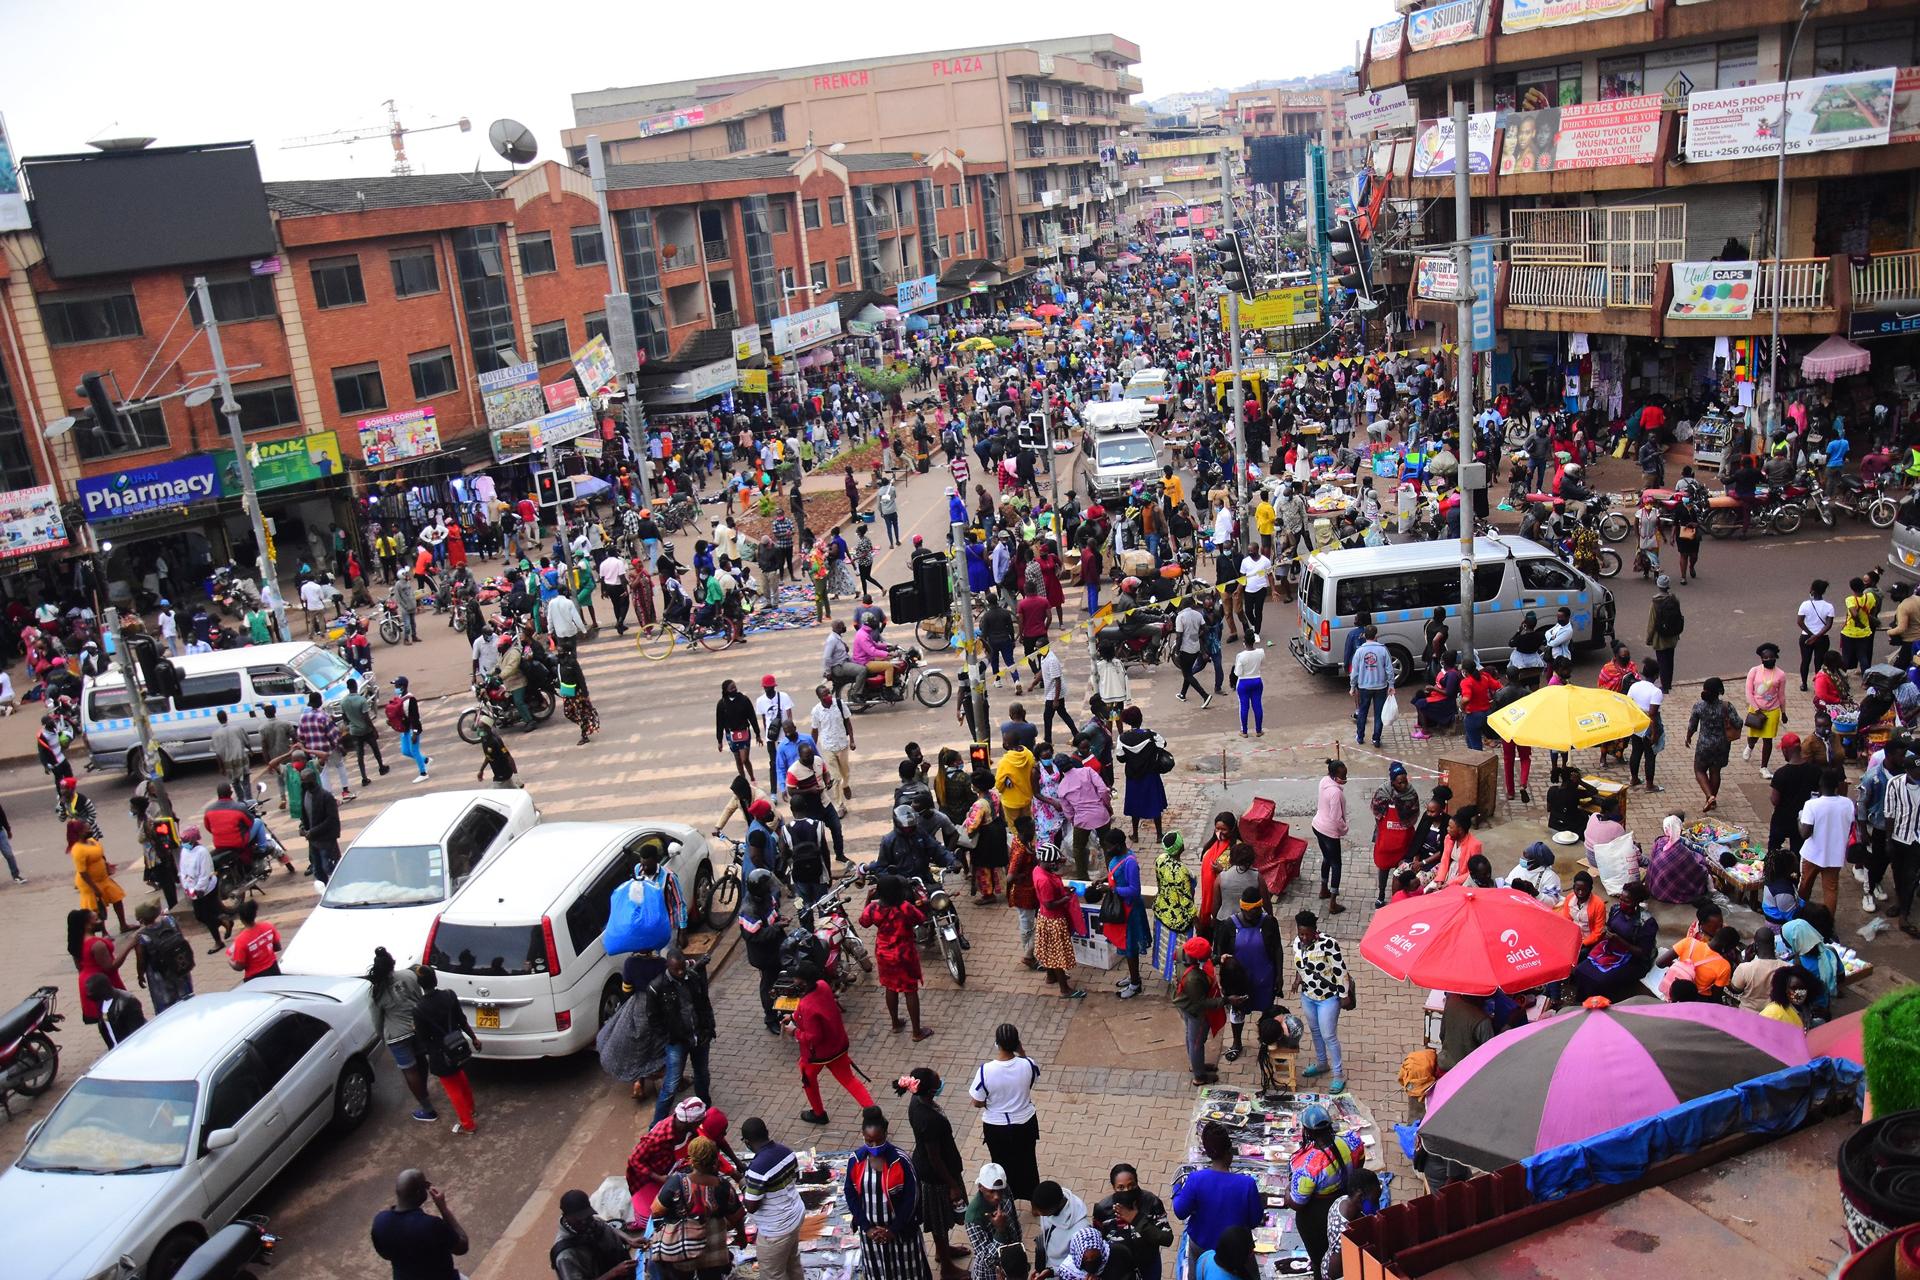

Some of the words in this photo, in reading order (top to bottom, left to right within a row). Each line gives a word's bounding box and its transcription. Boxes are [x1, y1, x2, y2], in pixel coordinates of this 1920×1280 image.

[1542, 2, 1581, 17] FINANCIAL
[813, 69, 869, 92] FRENCH
[931, 56, 983, 77] PLAZA
[1561, 105, 1587, 117] BABY
[1588, 102, 1614, 114] FACE
[1692, 98, 1739, 112] DREAMS
[1727, 105, 1765, 115] MASTERS
[1563, 119, 1589, 129] WHICH
[1589, 115, 1620, 127] NUMBER
[1623, 113, 1639, 123] ARE
[1571, 130, 1600, 141] JANGU
[1603, 125, 1650, 137] TUKOLEKO
[1575, 137, 1628, 149] OKUSINZILA
[1629, 135, 1642, 144] KU
[1577, 147, 1608, 157] NAMBA
[1692, 150, 1713, 159] TEL:
[1716, 147, 1740, 156] +256
[1557, 159, 1575, 169] Call:
[1576, 154, 1628, 168] 0700-852230
[1427, 261, 1453, 274] BRIGHT
[1714, 271, 1744, 279] CAPS
[900, 281, 927, 303] ELEGANT
[1881, 318, 1920, 332] SLEE
[480, 369, 506, 385] MOVIE
[507, 362, 536, 378] CENTRE
[365, 415, 394, 427] GOMESI
[394, 410, 425, 421] CORNER
[19, 486, 49, 496] POINT
[85, 473, 214, 513] Pharmacy
[1389, 933, 1417, 952] airtel
[1384, 943, 1403, 959] money
[1505, 945, 1540, 964] airtel
[1515, 959, 1542, 971] money
[479, 1017, 498, 1027] 271R
